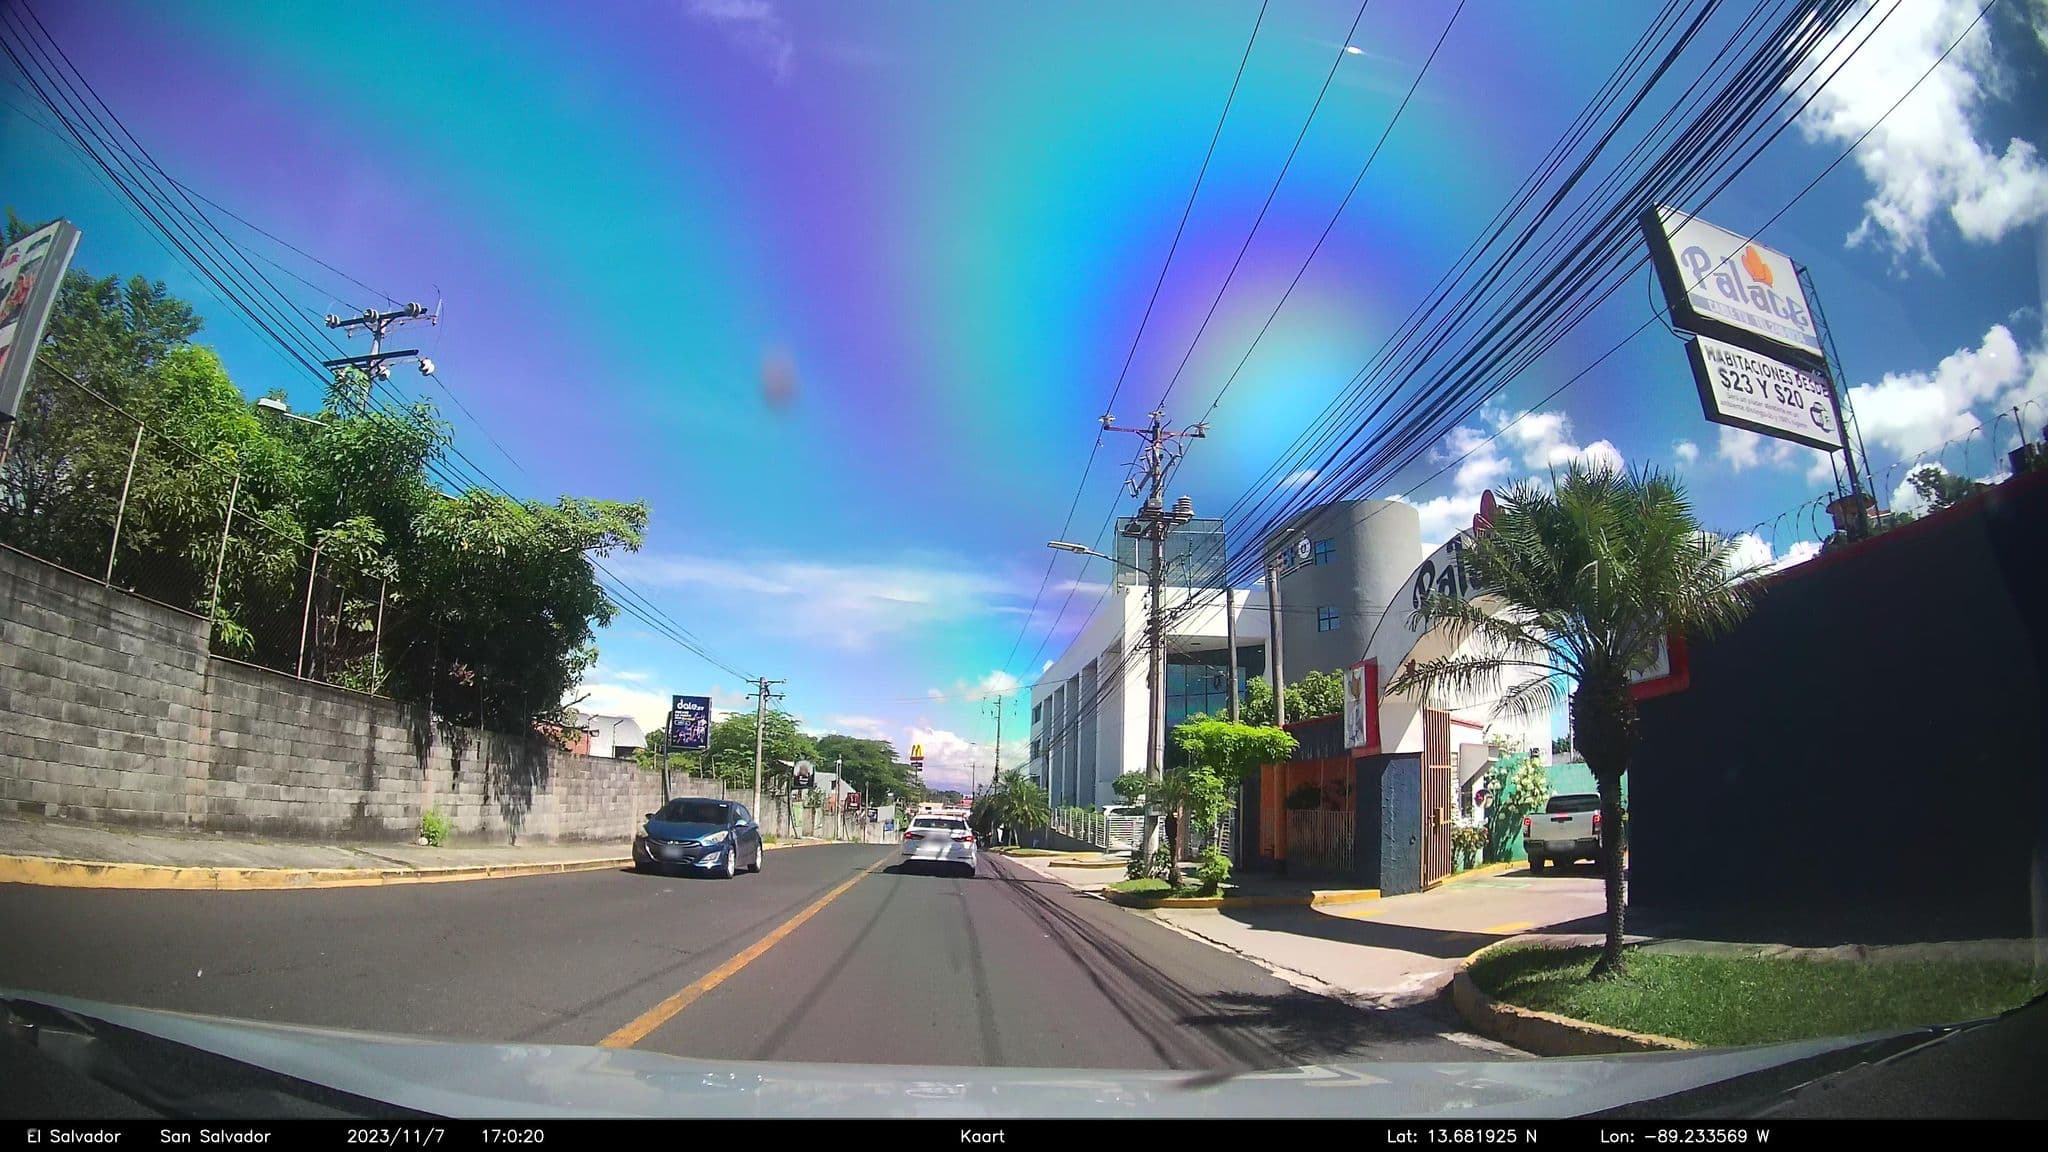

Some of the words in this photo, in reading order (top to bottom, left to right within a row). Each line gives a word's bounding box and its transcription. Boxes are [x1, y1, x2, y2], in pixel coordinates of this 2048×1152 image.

[1681, 246, 1808, 331] Palace
[1704, 345, 1793, 385] HABITACIONES
[1795, 371, 1830, 398] DESDE
[1719, 367, 1753, 395] $23
[1756, 378, 1769, 399] Y
[1774, 383, 1804, 410] $20
